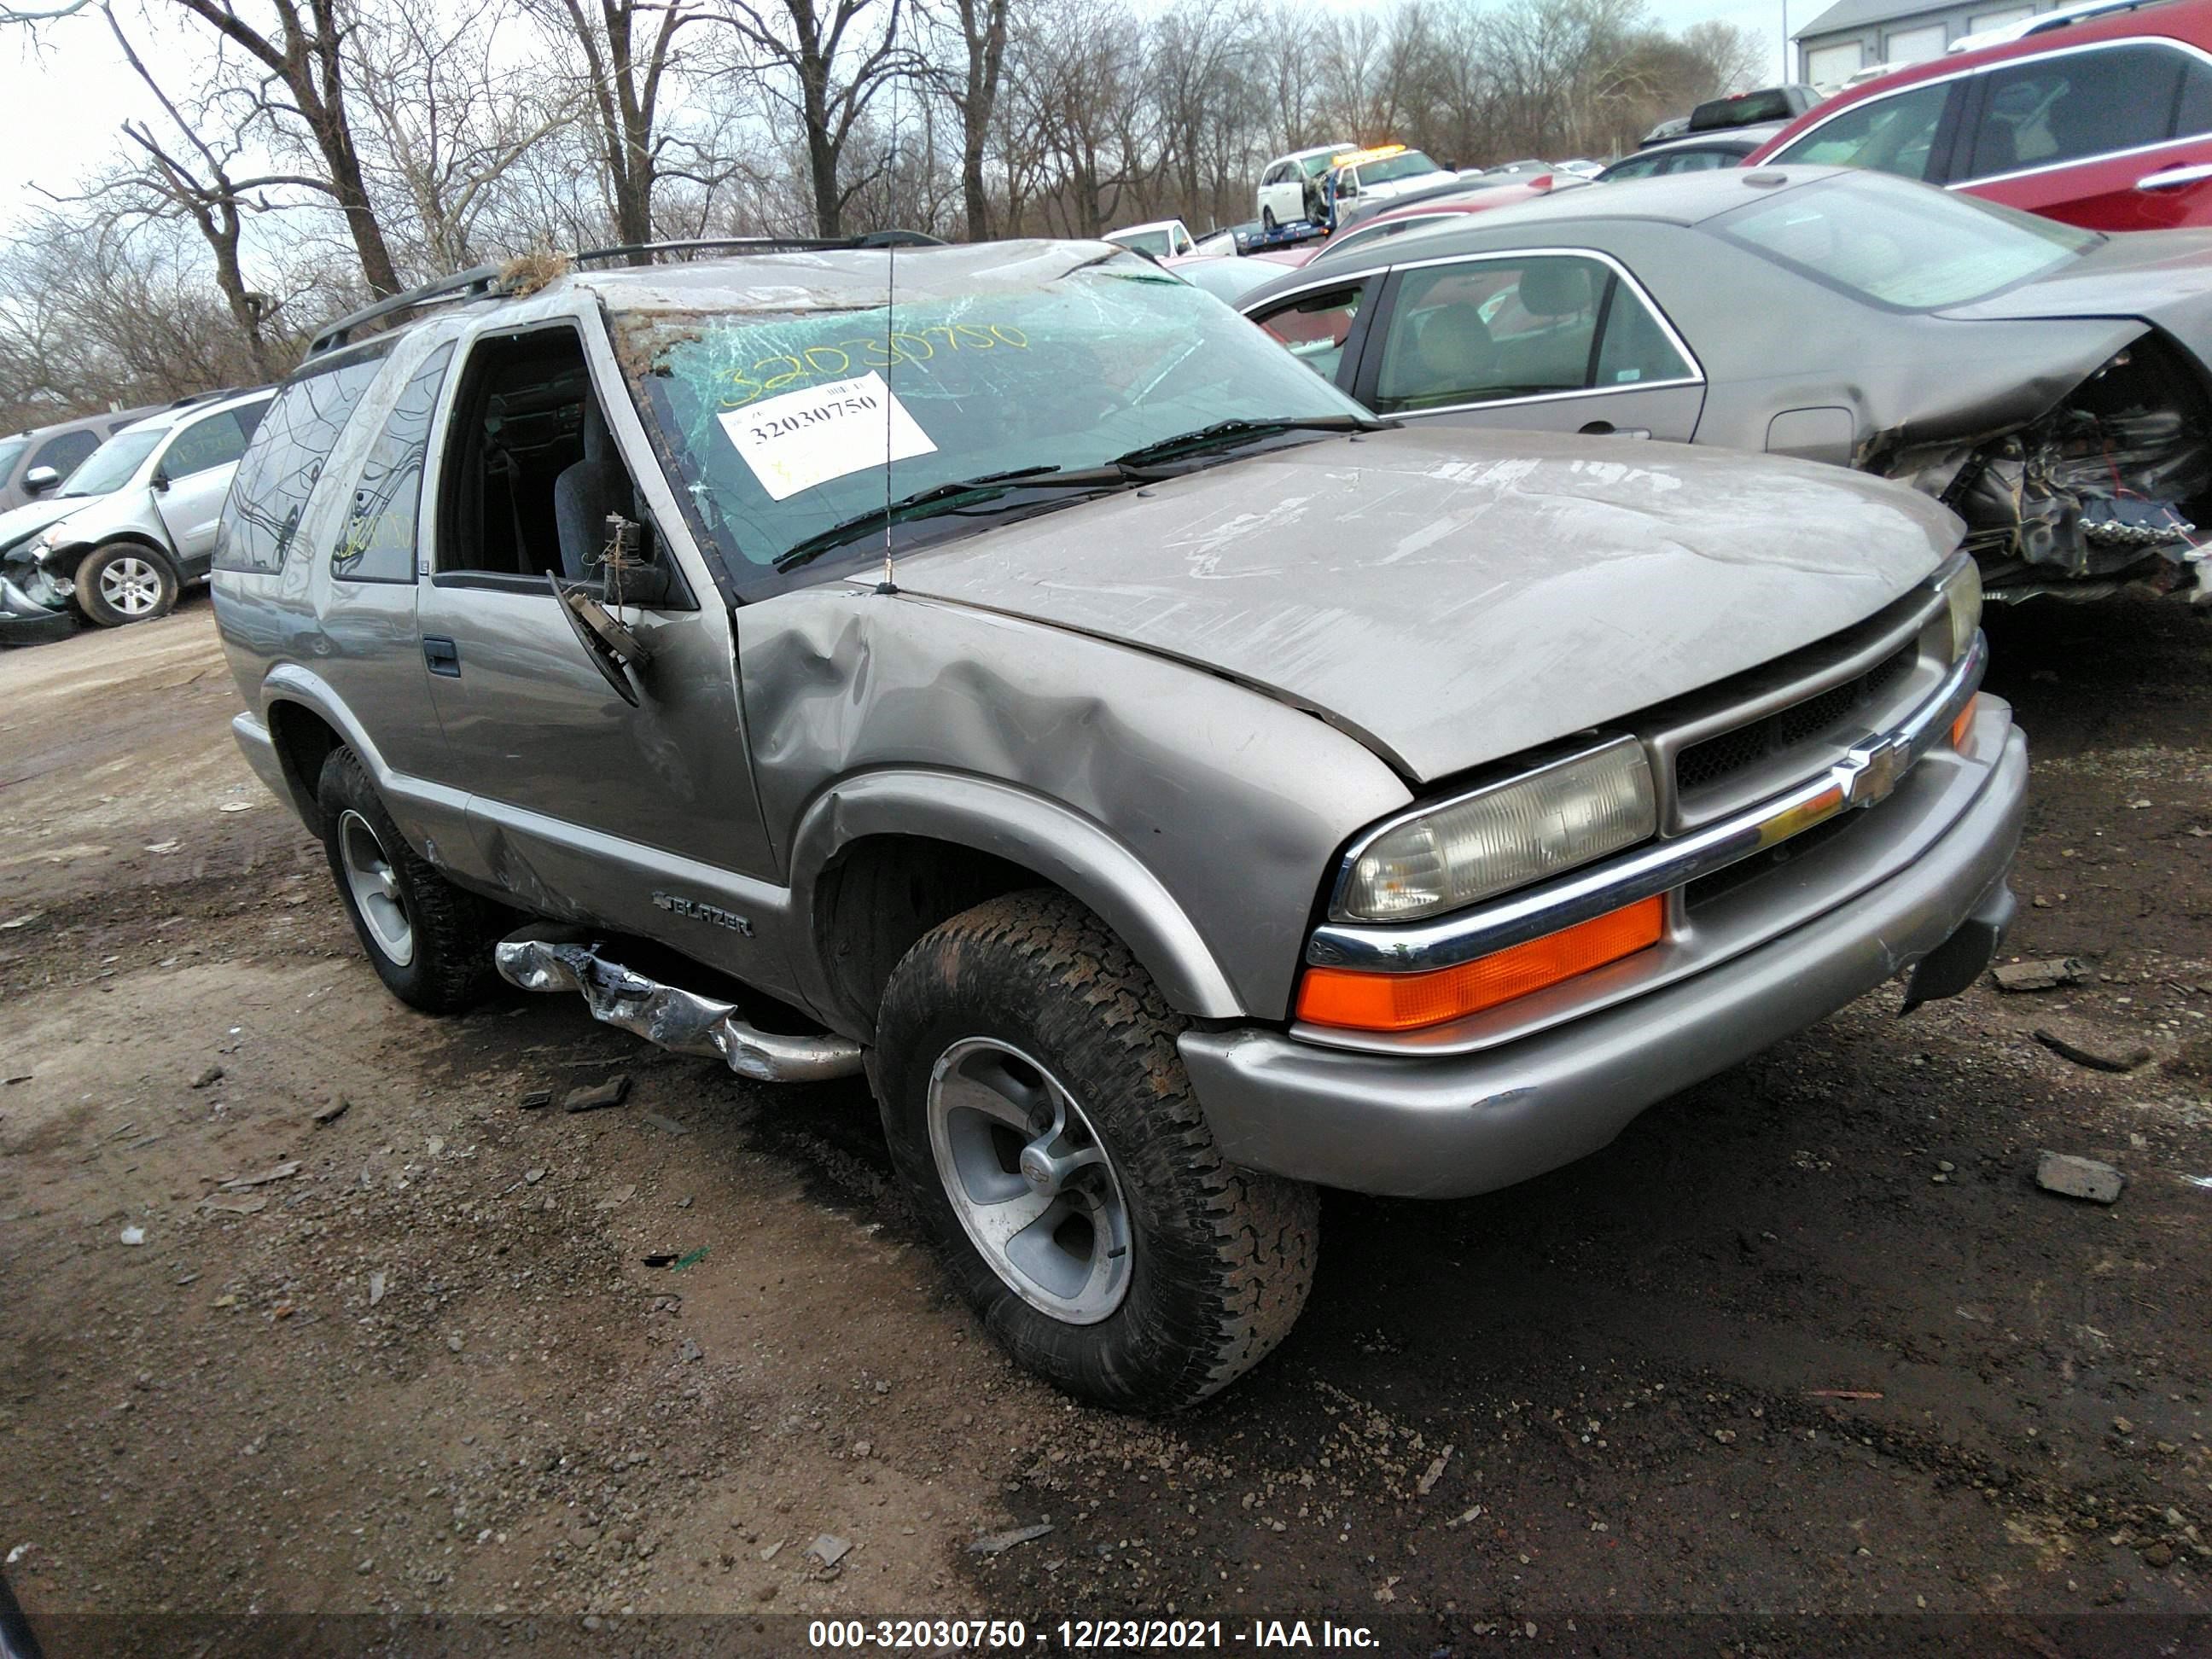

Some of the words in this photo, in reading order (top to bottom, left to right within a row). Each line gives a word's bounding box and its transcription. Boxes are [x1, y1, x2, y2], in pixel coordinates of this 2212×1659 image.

[716, 324, 1028, 408] 32030750
[749, 395, 877, 445] 32030750
[672, 896, 755, 939] BLAZER
